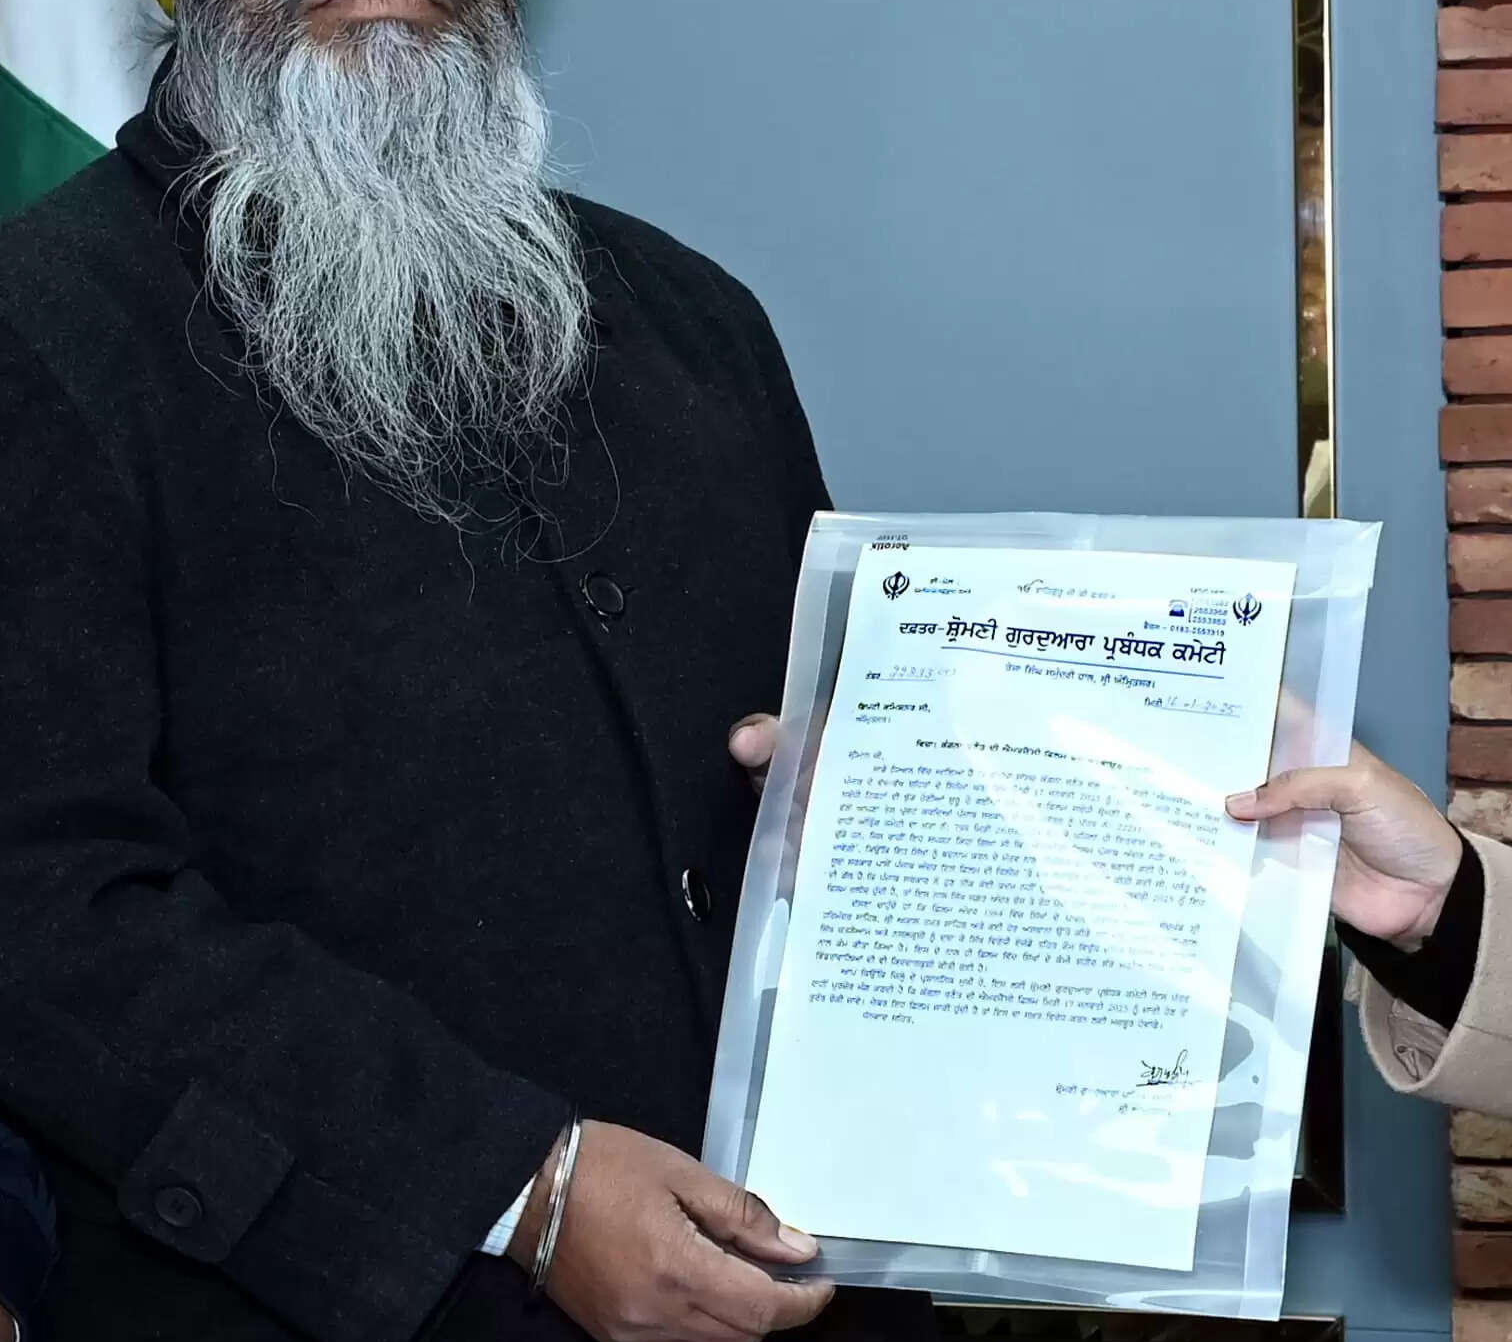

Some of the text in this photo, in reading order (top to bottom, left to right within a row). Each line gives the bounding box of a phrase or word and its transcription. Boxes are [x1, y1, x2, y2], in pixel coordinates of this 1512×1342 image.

[1005, 626, 1096, 652] ਗੁਰਦੁਆਰਾ
[1104, 631, 1166, 660] ਪ੍ਰਬੰਧਕ
[1172, 639, 1227, 665] ਕਮੇਟੀ
